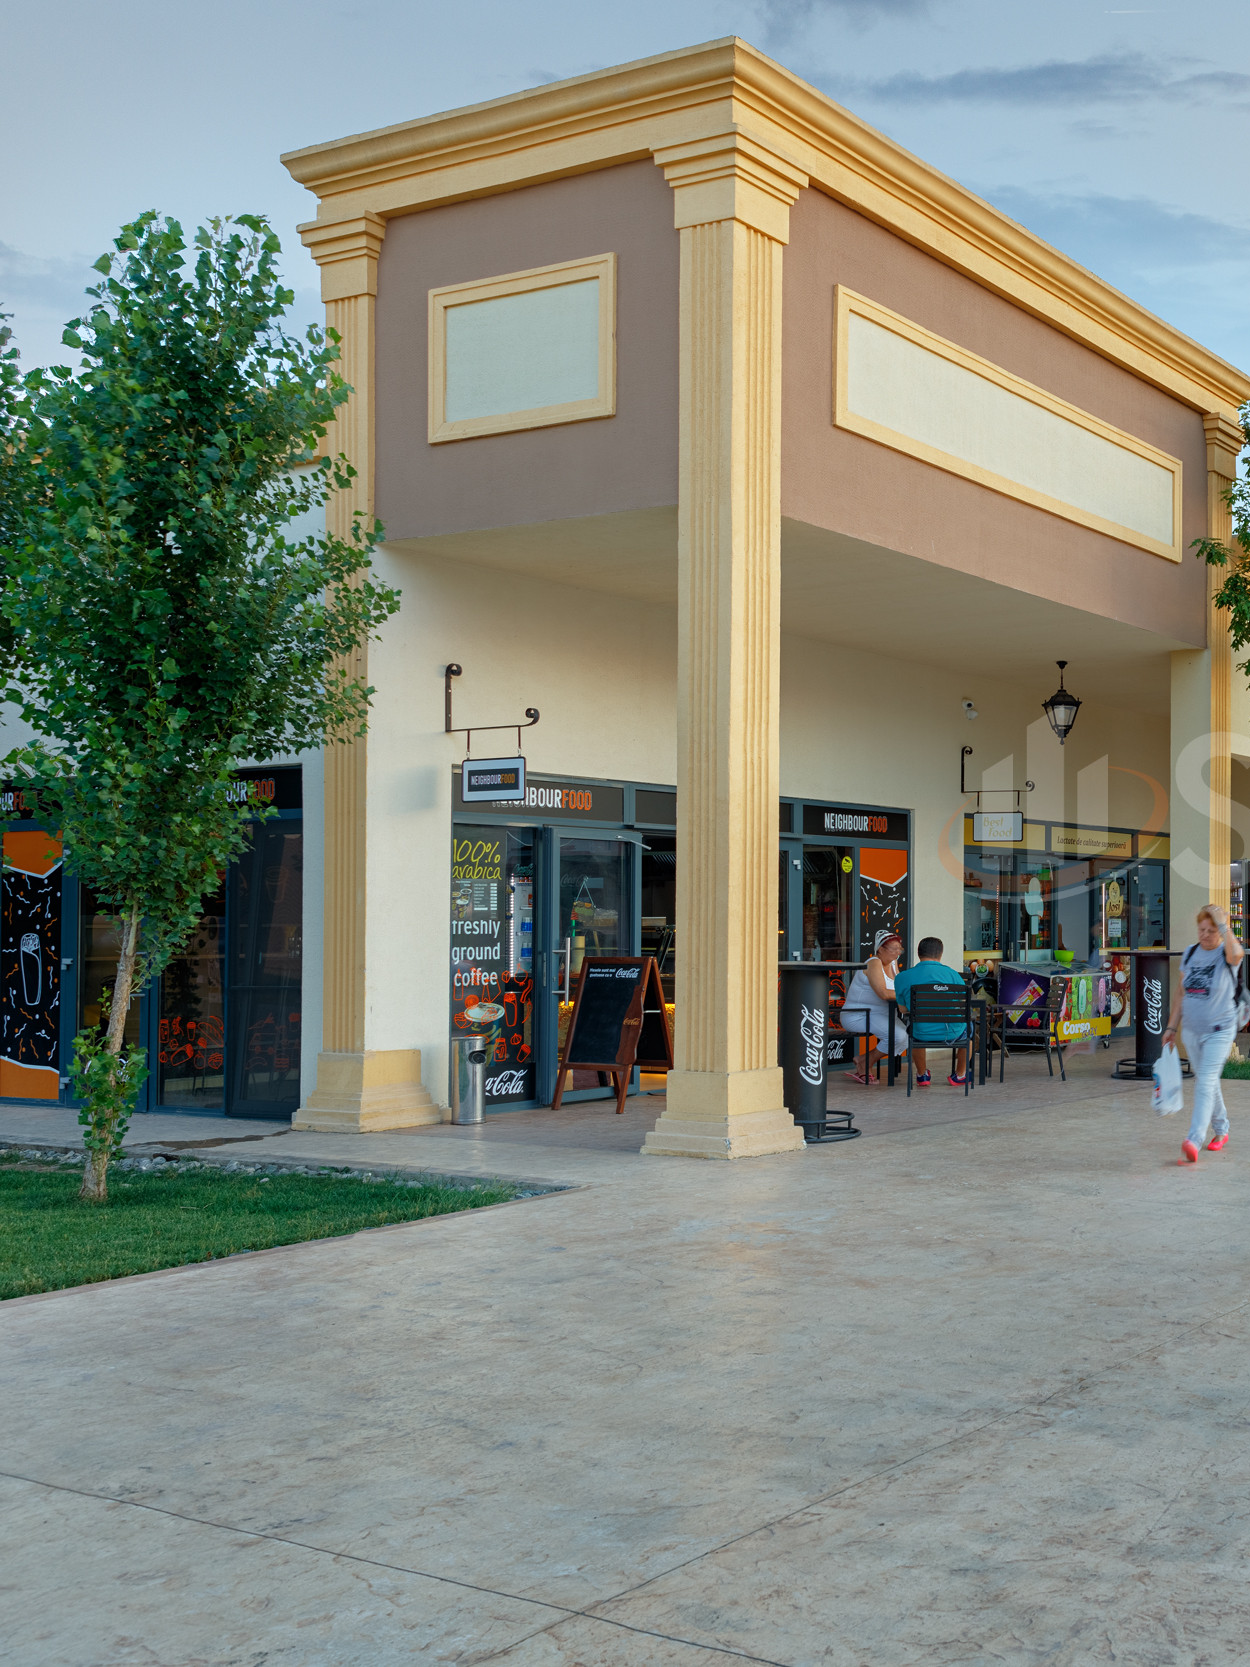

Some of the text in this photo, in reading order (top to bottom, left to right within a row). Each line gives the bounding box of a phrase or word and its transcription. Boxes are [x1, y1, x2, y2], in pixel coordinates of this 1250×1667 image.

[470, 773, 516, 786] NEIGHBOURFOOD
[824, 812, 888, 833] NEIGHBOURFOOD
[983, 816, 1004, 828] Best
[453, 838, 501, 864] 100%
[1077, 837, 1083, 845] de
[1083, 838, 1101, 847] calitate
[452, 859, 502, 880] arabica
[452, 942, 501, 965] ground
[454, 967, 498, 987] coffee
[1143, 975, 1162, 1035] Coca-Cola
[1063, 1021, 1091, 1036] Corso
[799, 1003, 825, 1086] Coca-Cola
